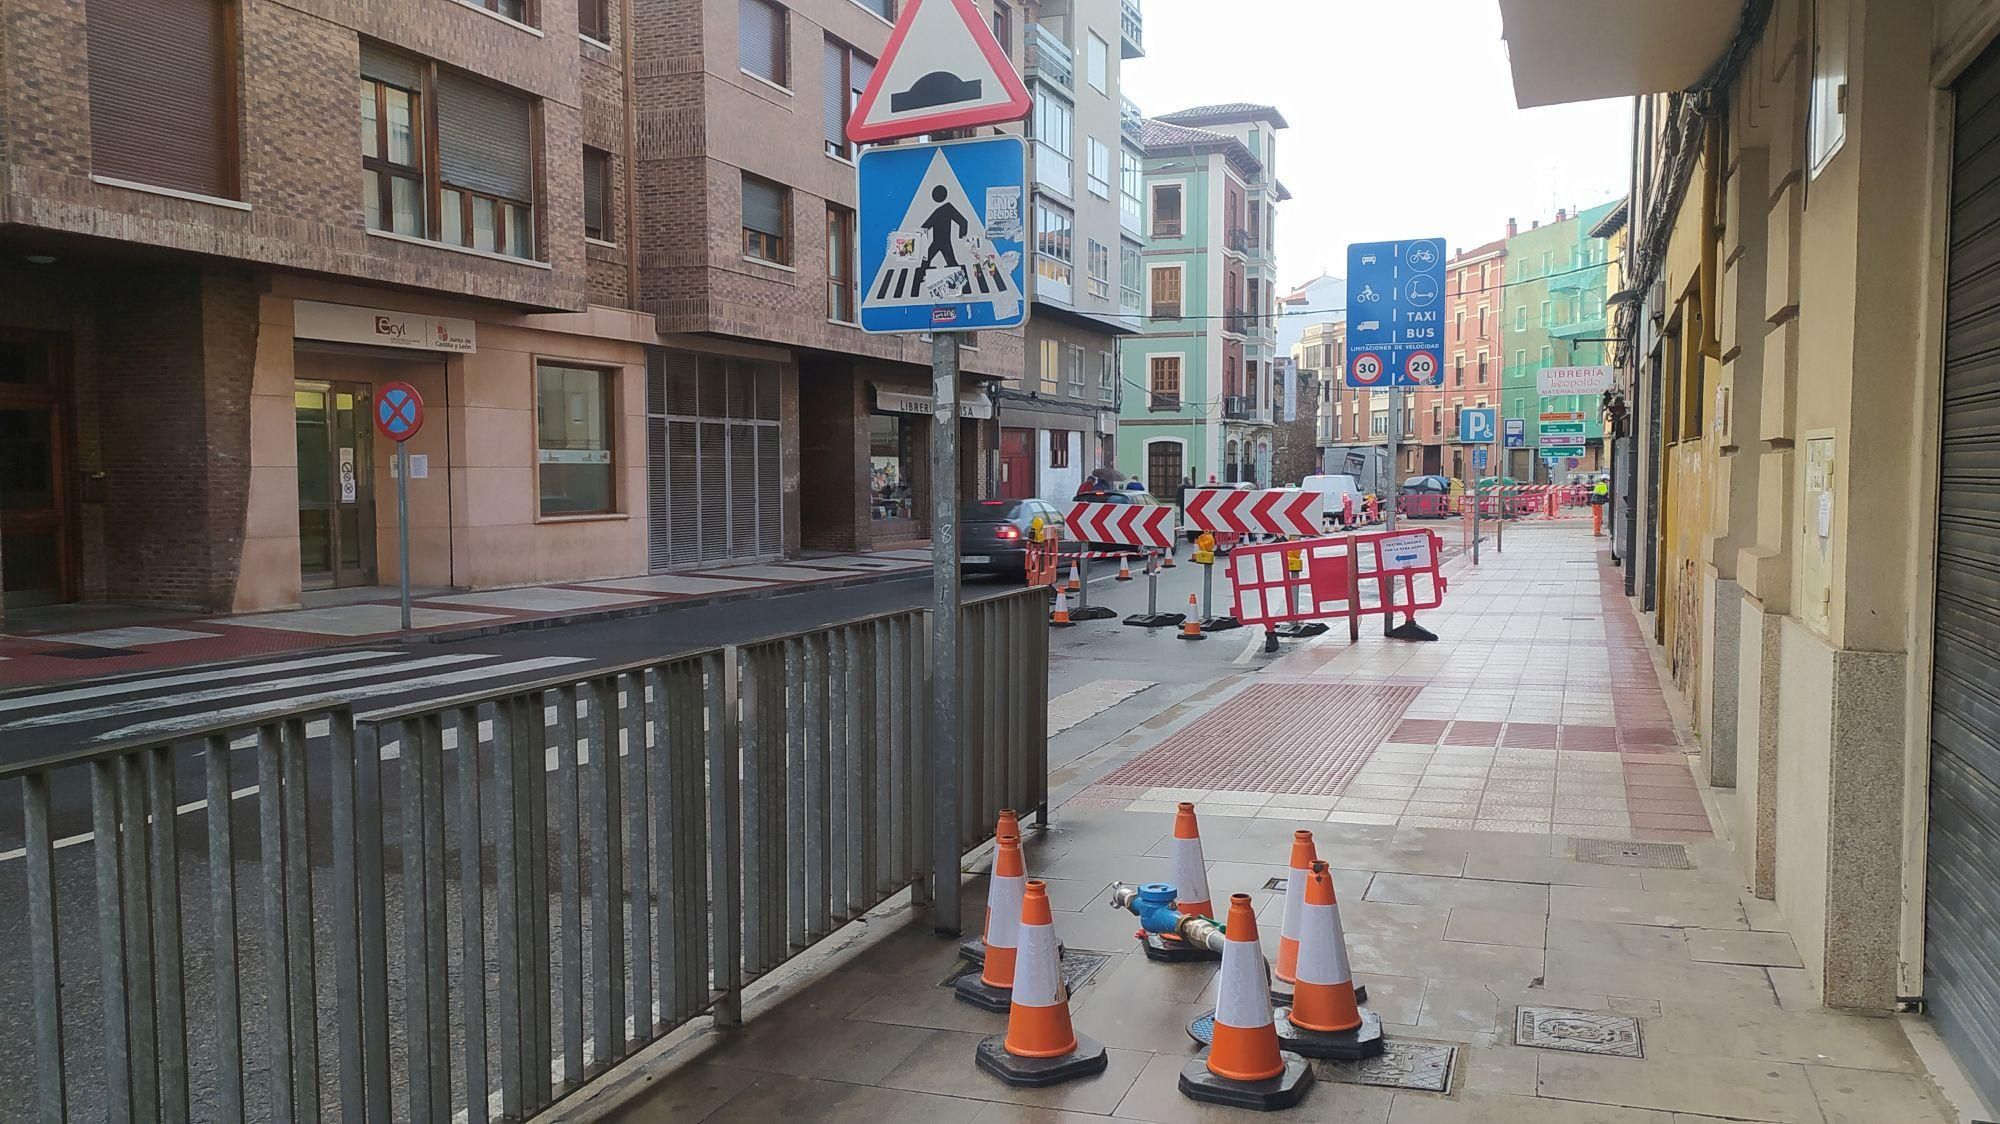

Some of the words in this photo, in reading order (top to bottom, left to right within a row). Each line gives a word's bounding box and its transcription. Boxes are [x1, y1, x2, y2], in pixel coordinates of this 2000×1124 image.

[992, 195, 1018, 209] UNO
[988, 209, 1018, 220] DECIDES
[1407, 311, 1436, 322] TAXI
[1406, 328, 1435, 338] BUS
[1358, 363, 1376, 374] 30
[1411, 361, 1430, 373] 20
[1547, 369, 1604, 378] LIBRERÍA
[1551, 378, 1600, 388] Leopoldo
[1470, 412, 1486, 439] P
